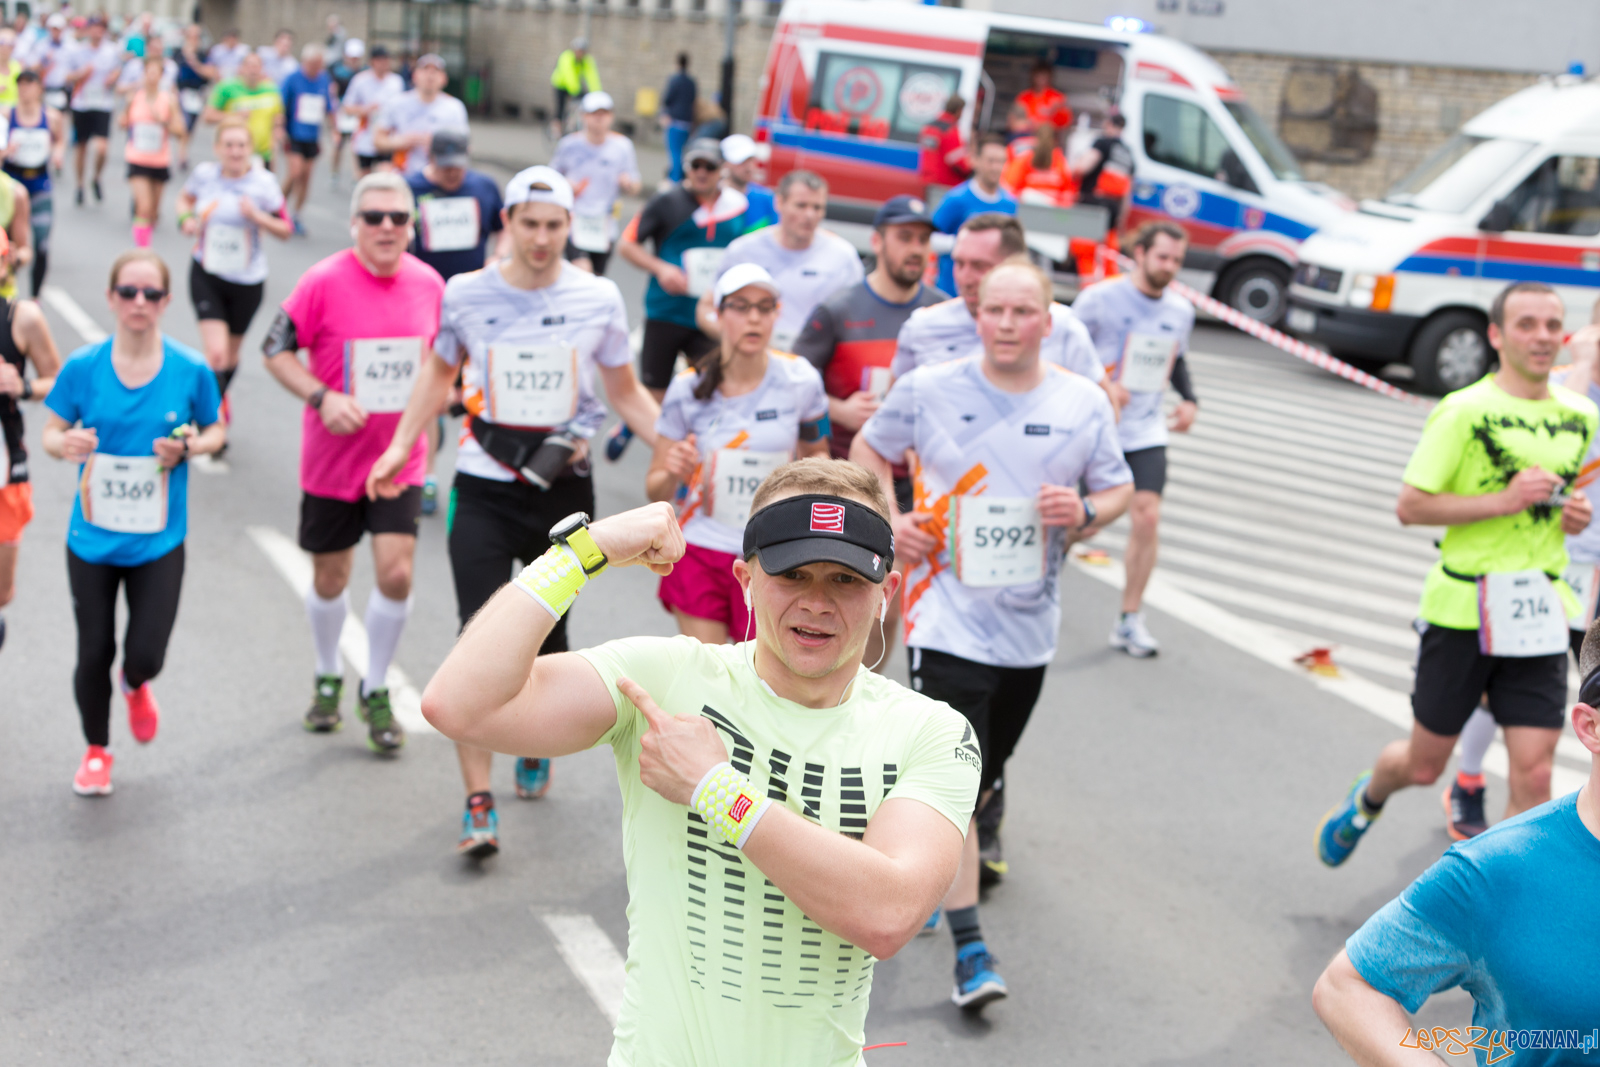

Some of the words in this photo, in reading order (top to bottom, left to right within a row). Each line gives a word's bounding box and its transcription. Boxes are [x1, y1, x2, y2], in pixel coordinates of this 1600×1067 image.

[366, 360, 414, 379] 4759
[504, 371, 564, 390] 12127
[101, 480, 155, 500] 3369
[728, 475, 764, 495] 119
[974, 525, 1036, 547] 5992
[1511, 597, 1549, 619] 214
